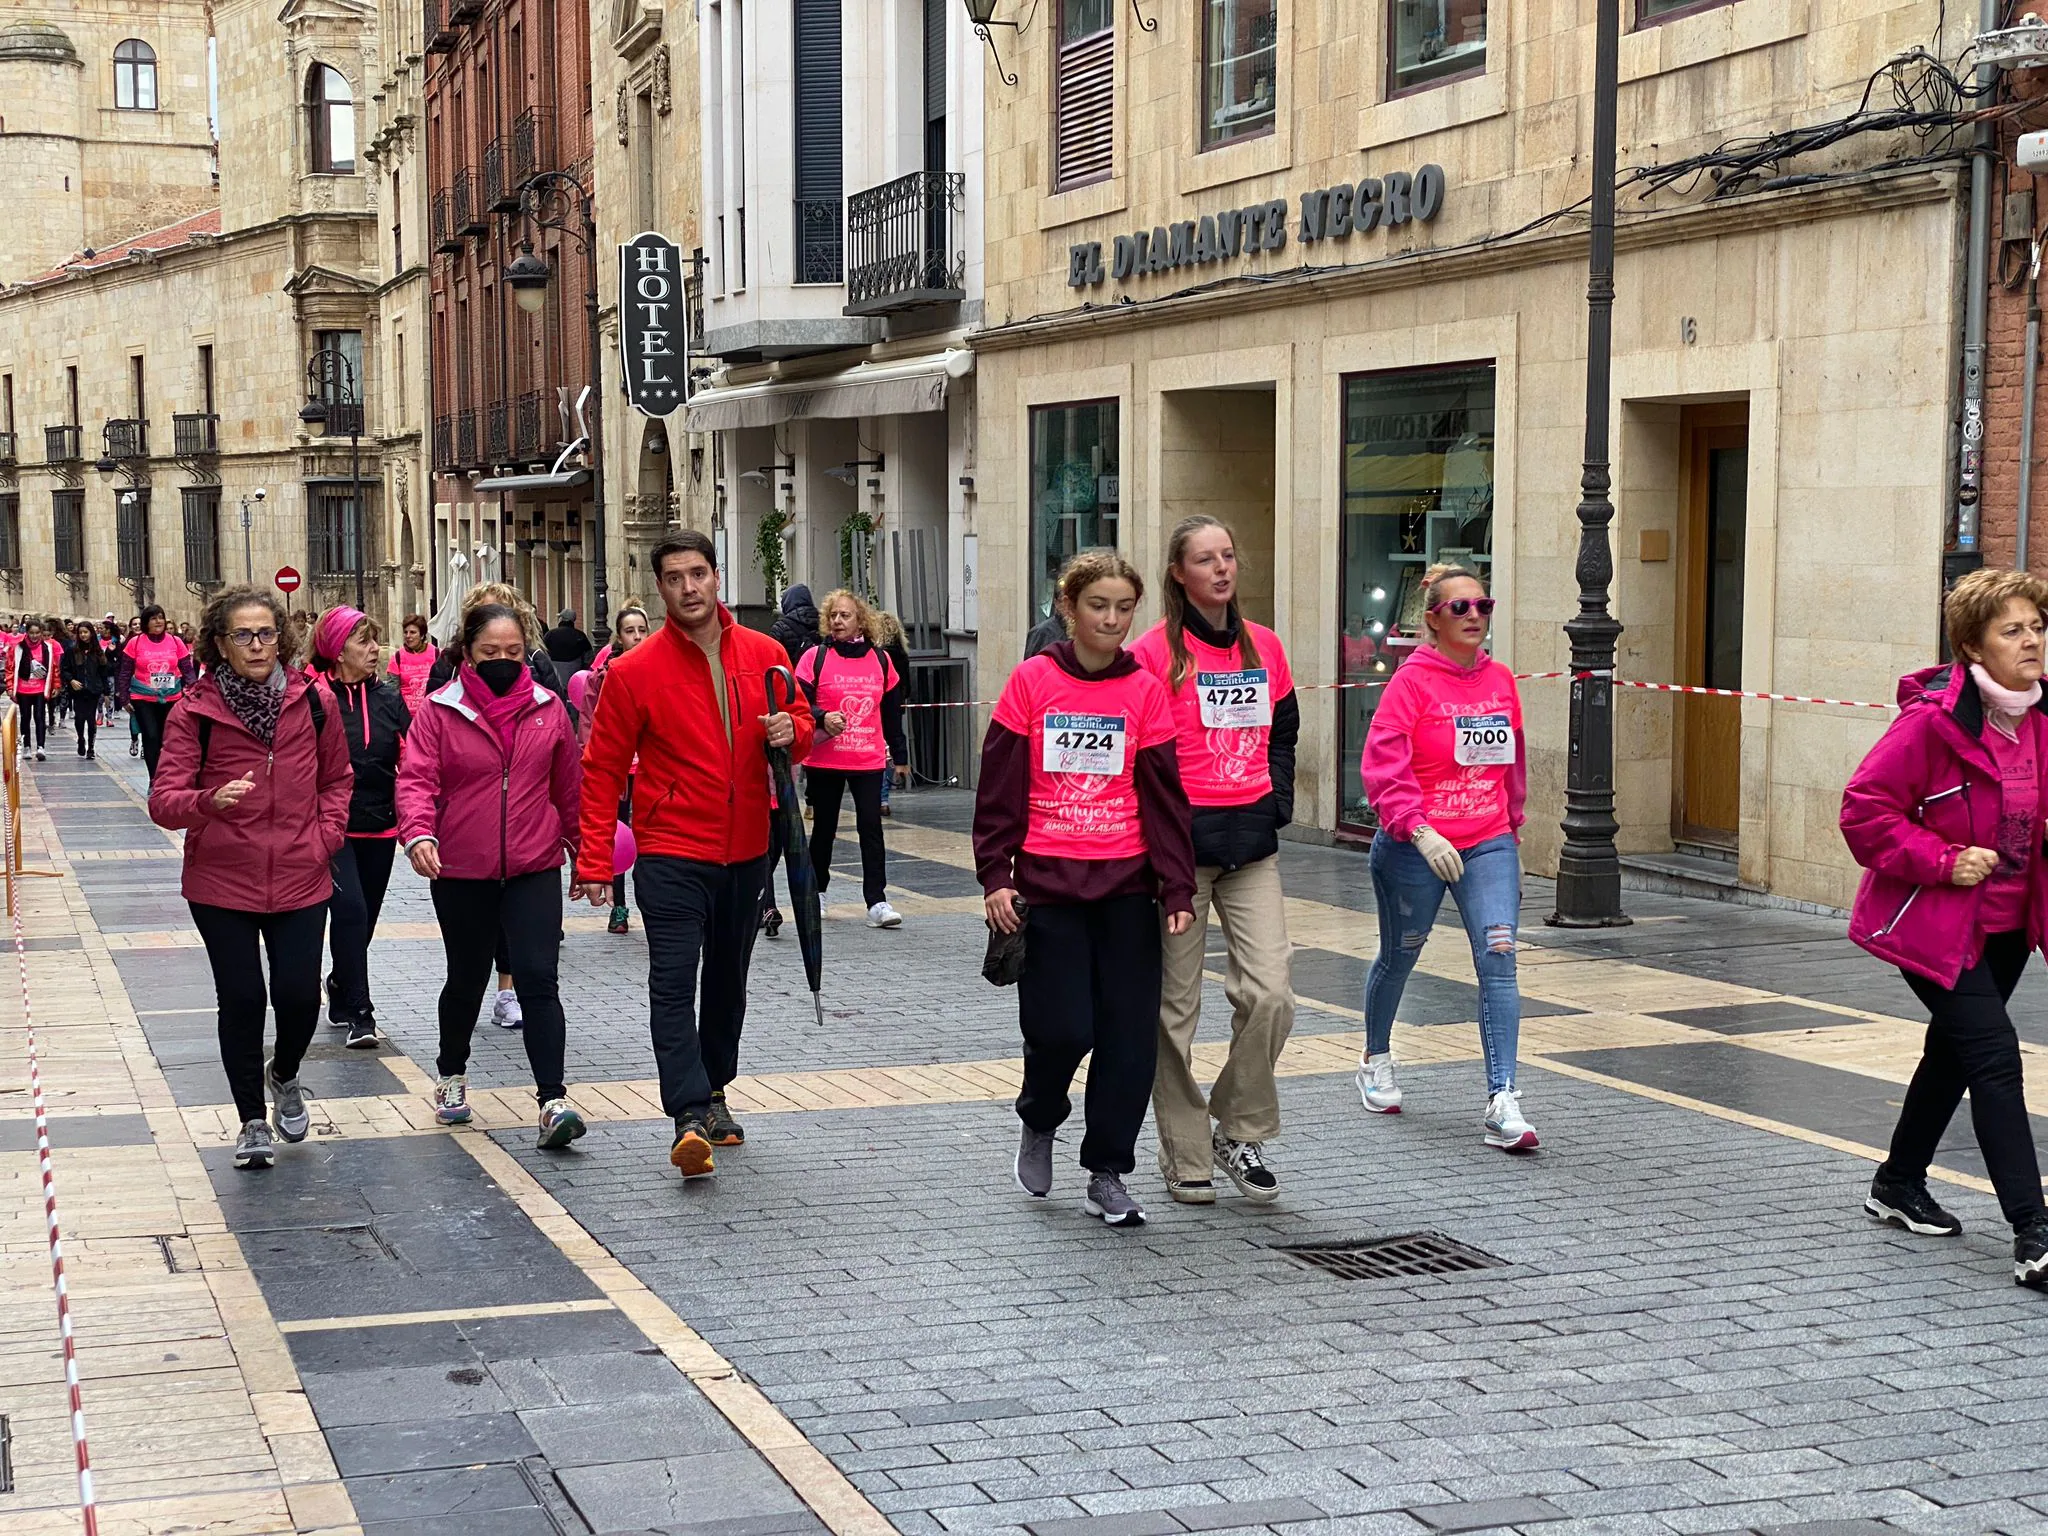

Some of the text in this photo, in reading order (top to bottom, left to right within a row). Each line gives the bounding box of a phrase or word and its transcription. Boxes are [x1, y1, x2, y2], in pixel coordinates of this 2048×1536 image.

[1068, 164, 1445, 287] EL DIAMANTE NEGRO
[636, 247, 675, 384] HOTEL
[1206, 687, 1258, 706] 4722
[1070, 720, 1118, 730] solitium
[1056, 732, 1114, 751] 4724
[1463, 729, 1508, 746] 7000
